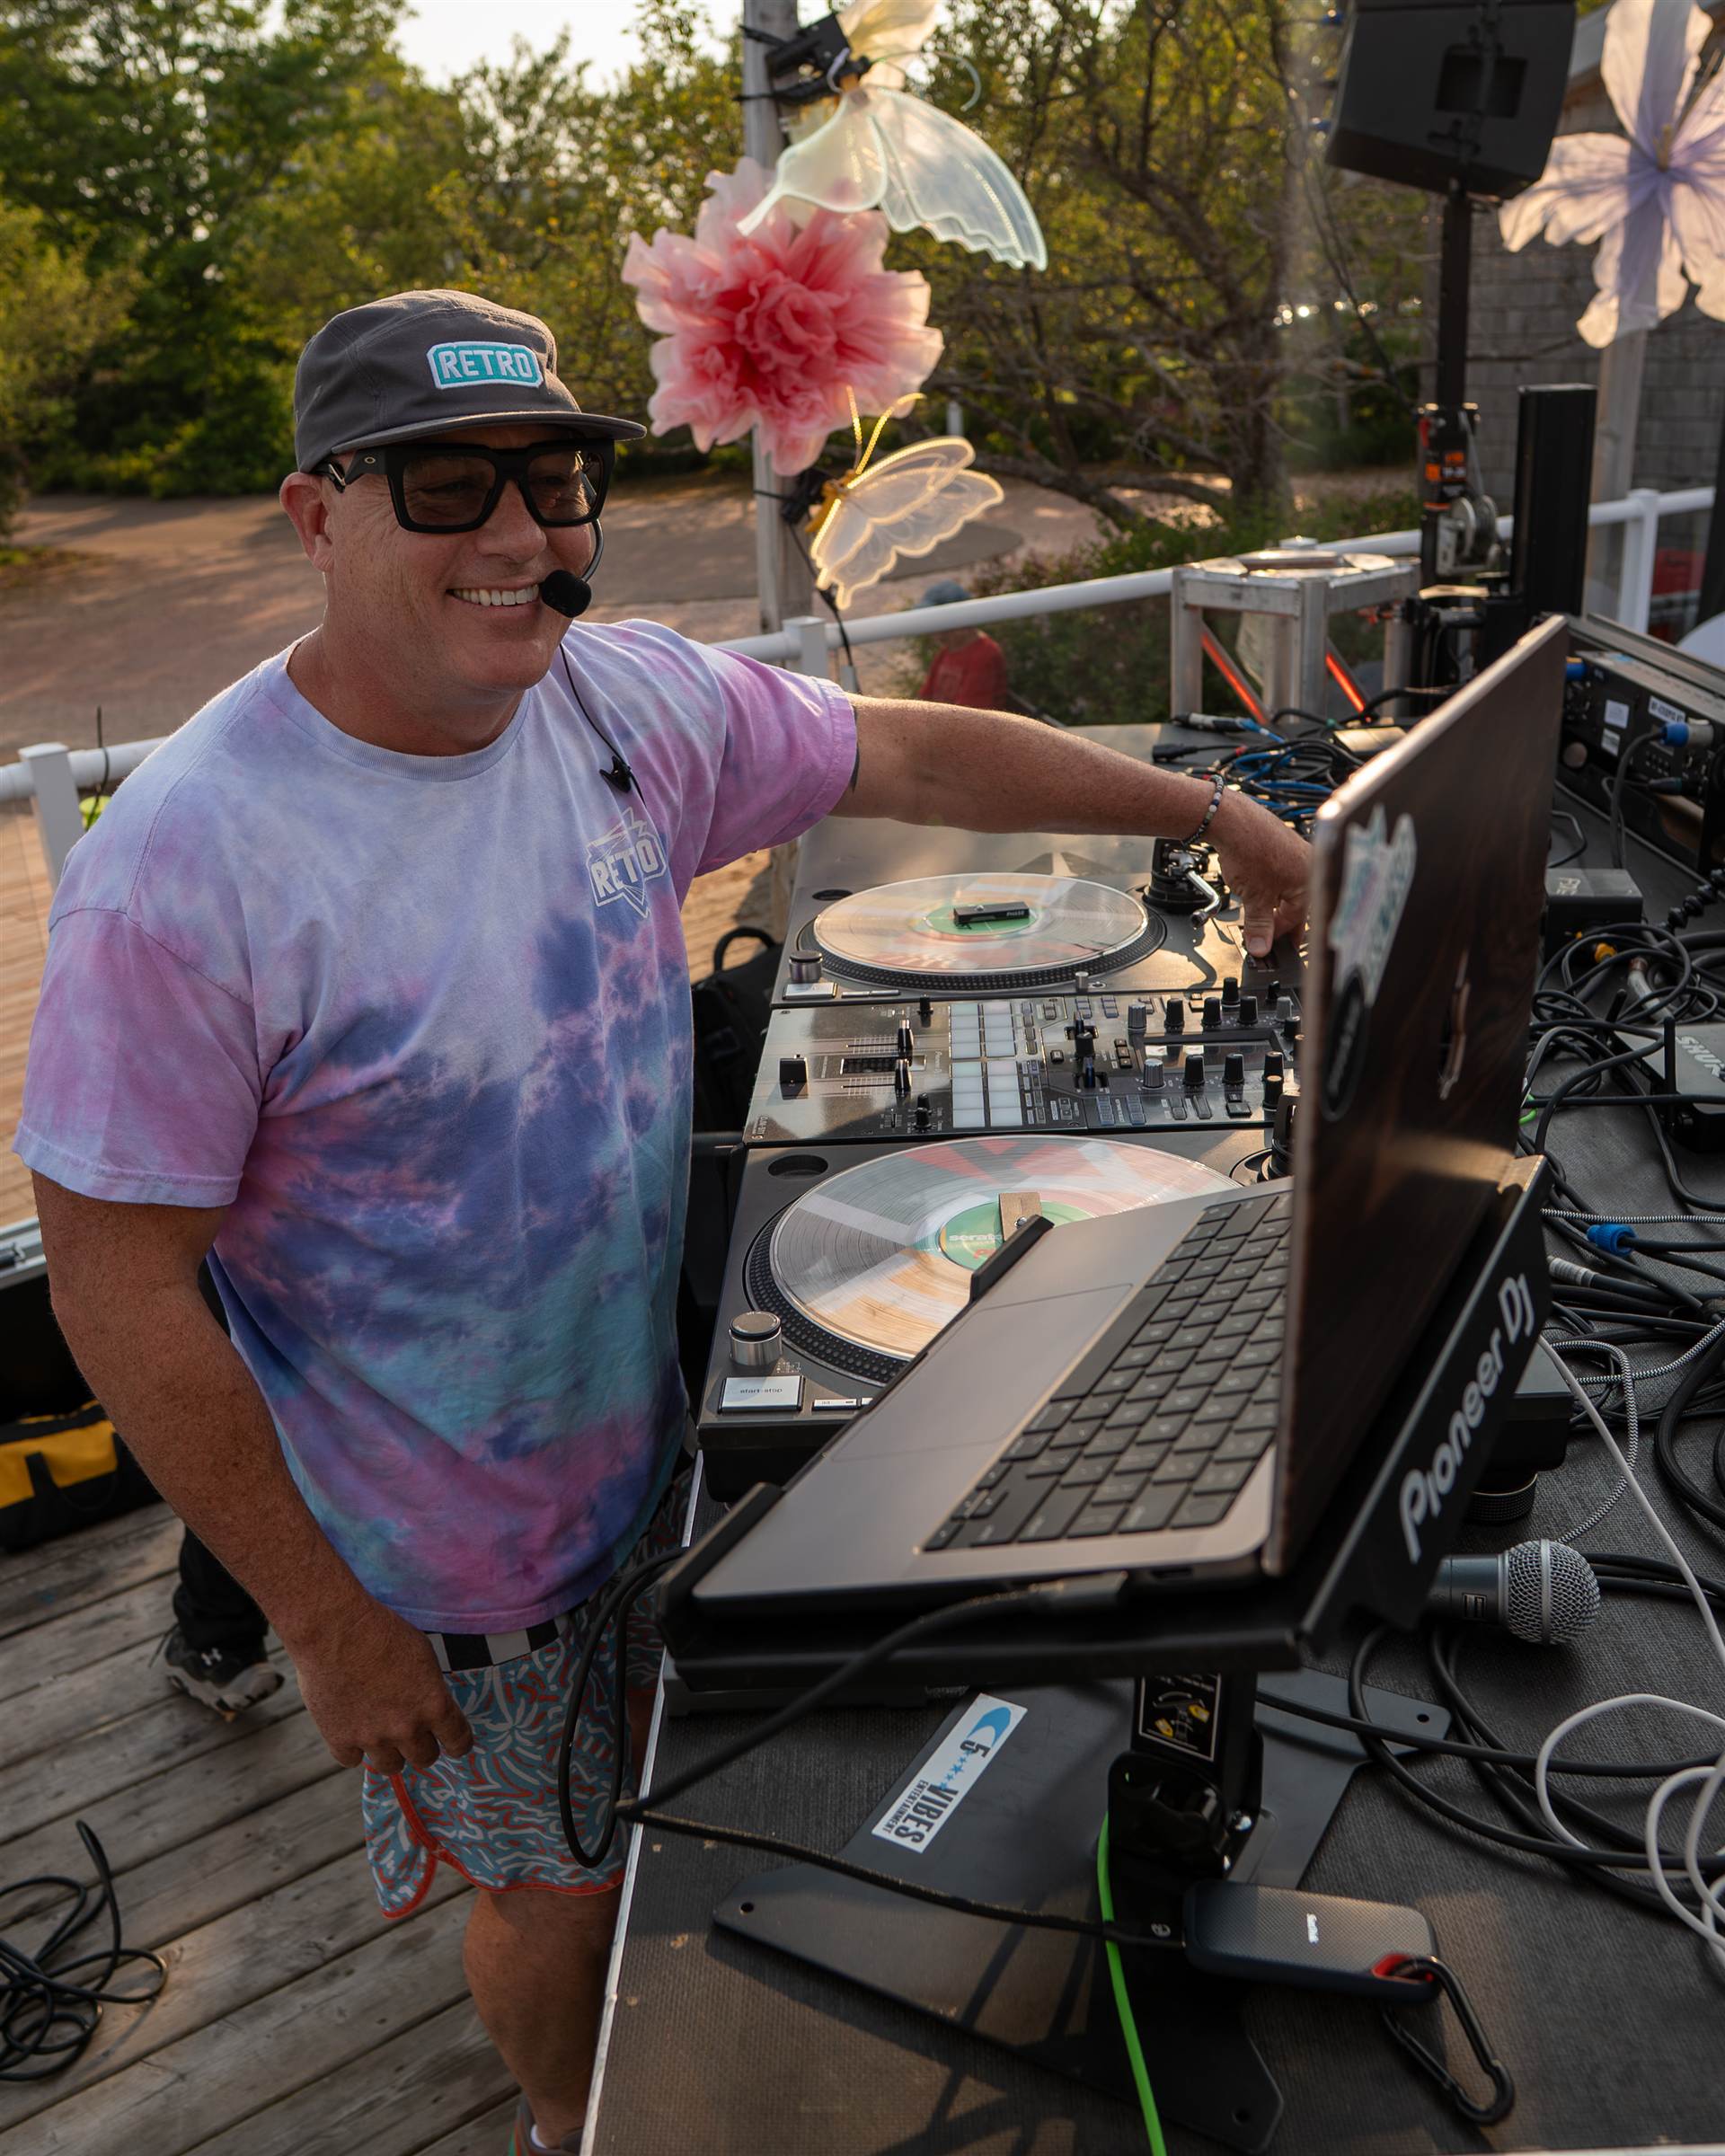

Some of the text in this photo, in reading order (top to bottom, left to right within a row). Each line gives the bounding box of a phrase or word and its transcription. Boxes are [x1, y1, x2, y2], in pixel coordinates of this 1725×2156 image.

[438, 349, 533, 379] RETRO
[590, 838, 659, 899] RETO
[1399, 1328, 1504, 1565] Pioneer
[960, 1739, 991, 1759] 5
[882, 1779, 929, 1833] ENTERTAINMENT
[894, 1783, 960, 1843] VIBES
